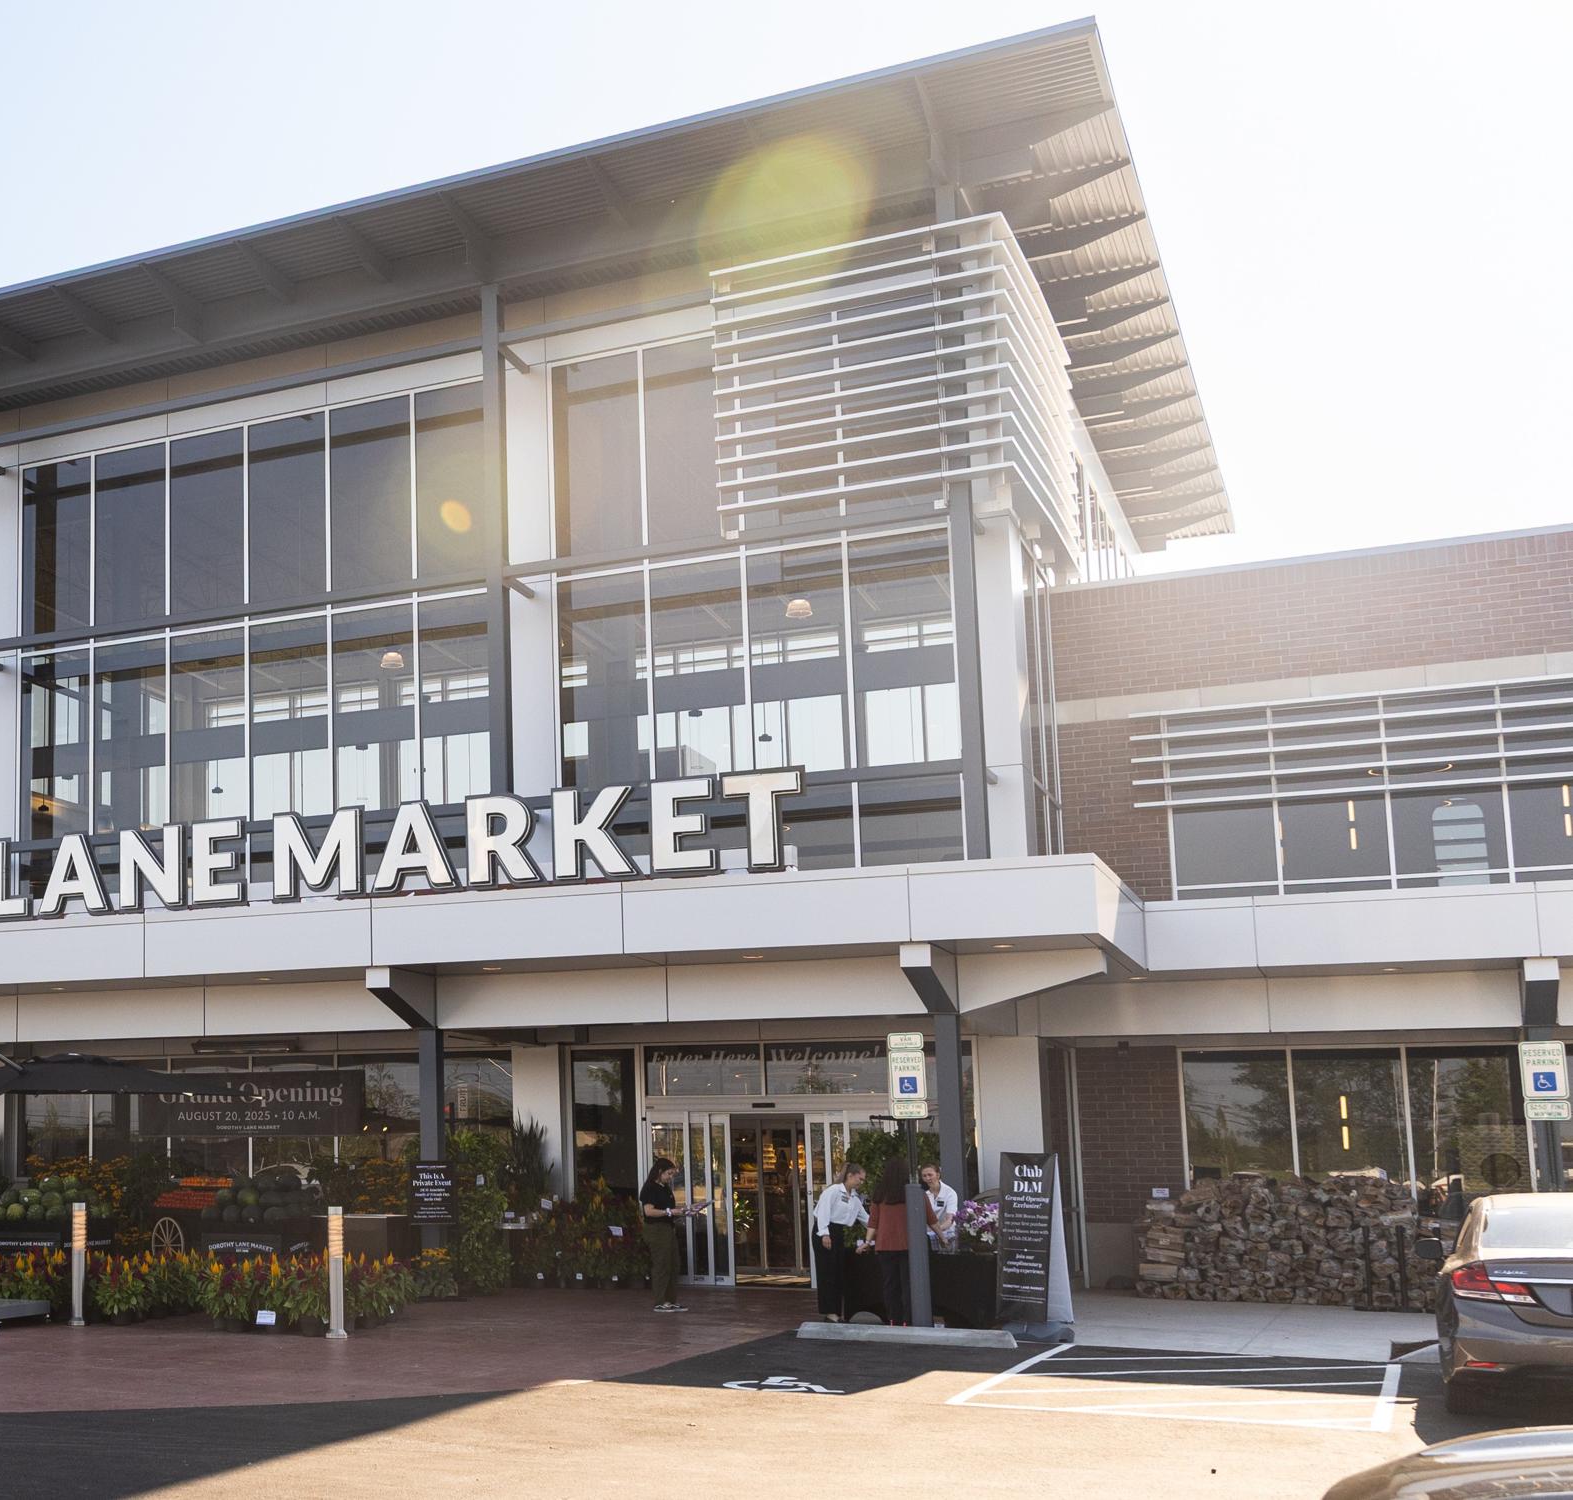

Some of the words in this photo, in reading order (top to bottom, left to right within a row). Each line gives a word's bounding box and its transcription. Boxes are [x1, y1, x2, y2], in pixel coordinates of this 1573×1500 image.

[273, 767, 804, 901] MARKET
[652, 1052, 703, 1065] Enter
[710, 1051, 755, 1065] Here
[771, 1045, 879, 1064] Welcome!
[239, 1081, 343, 1107] Opening
[178, 1111, 221, 1120] AUGUST
[225, 1111, 240, 1122] 20,
[245, 1111, 271, 1120] 2025
[282, 1110, 294, 1120] 10
[298, 1110, 321, 1120] A.M.
[1015, 1164, 1043, 1178] Club
[1013, 1181, 1042, 1193] DLM
[1026, 1195, 1050, 1203] Opening
[209, 1241, 234, 1250] DOROTHY
[250, 1242, 274, 1252] MARKET
